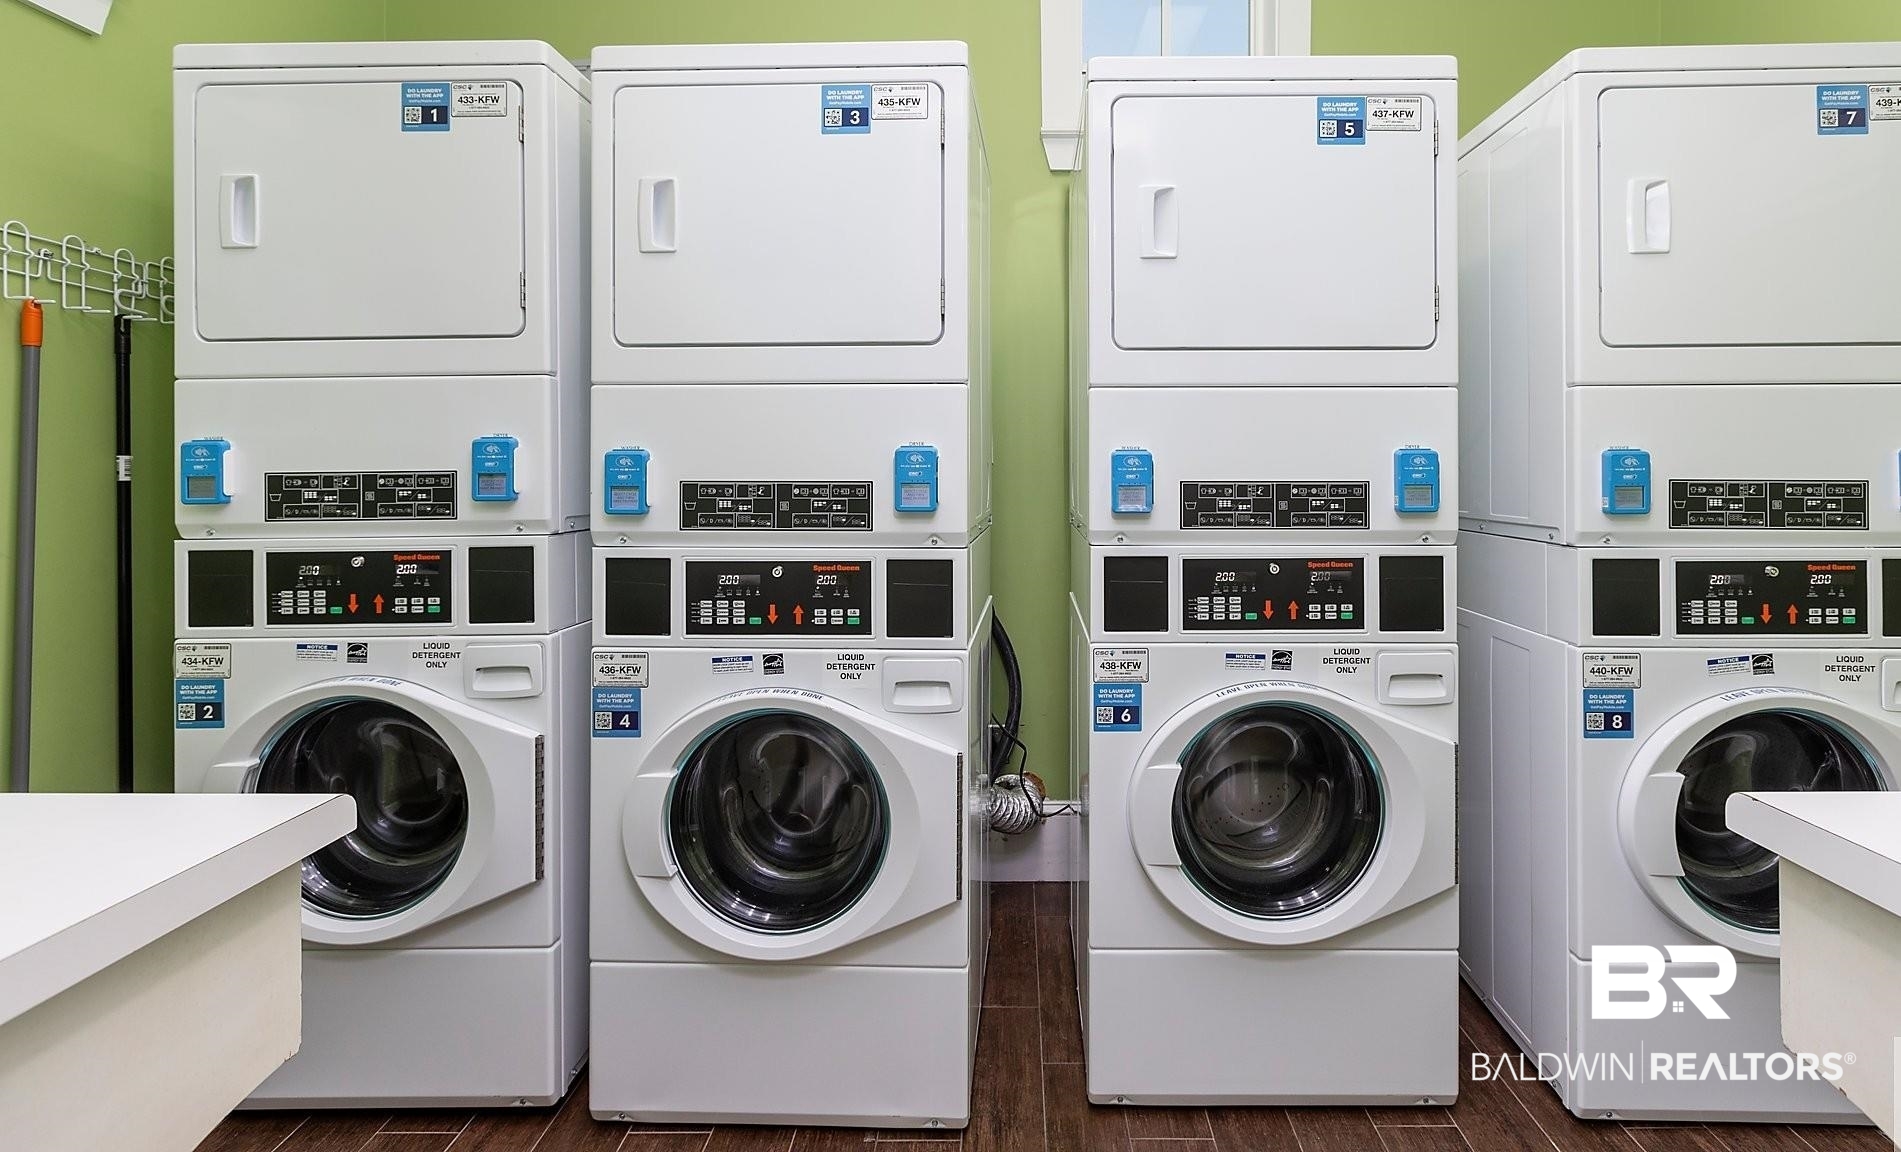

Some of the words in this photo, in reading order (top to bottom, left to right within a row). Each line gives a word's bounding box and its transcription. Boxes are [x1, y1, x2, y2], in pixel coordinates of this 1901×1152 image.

[458, 96, 500, 104] 433-KFW
[878, 98, 921, 106] 435-KFW
[430, 108, 438, 122] 1
[850, 110, 860, 124] 3
[1372, 110, 1414, 118] 437-KFW
[1846, 111, 1857, 125] 7
[1344, 122, 1355, 136] 5
[396, 564, 417, 574] 2.00
[719, 575, 739, 585] 2.00
[817, 575, 837, 584] 2.00
[1216, 572, 1236, 582] 2.00
[1311, 572, 1330, 581] 2.00
[1710, 575, 1731, 584] 2.00
[1810, 575, 1831, 584] 2.00
[1334, 648, 1360, 656] LIQUID
[182, 657, 224, 665] 434-KFW
[599, 666, 641, 674] 436-KFW
[1100, 662, 1142, 670] 438-KFW
[1590, 667, 1634, 675] 440-KFW
[801, 691, 824, 700] DONE
[1216, 686, 1242, 698] LEAVE
[203, 705, 214, 719] 2
[1121, 709, 1131, 722] 6
[620, 714, 630, 727] 4
[1612, 715, 1622, 728] 8
